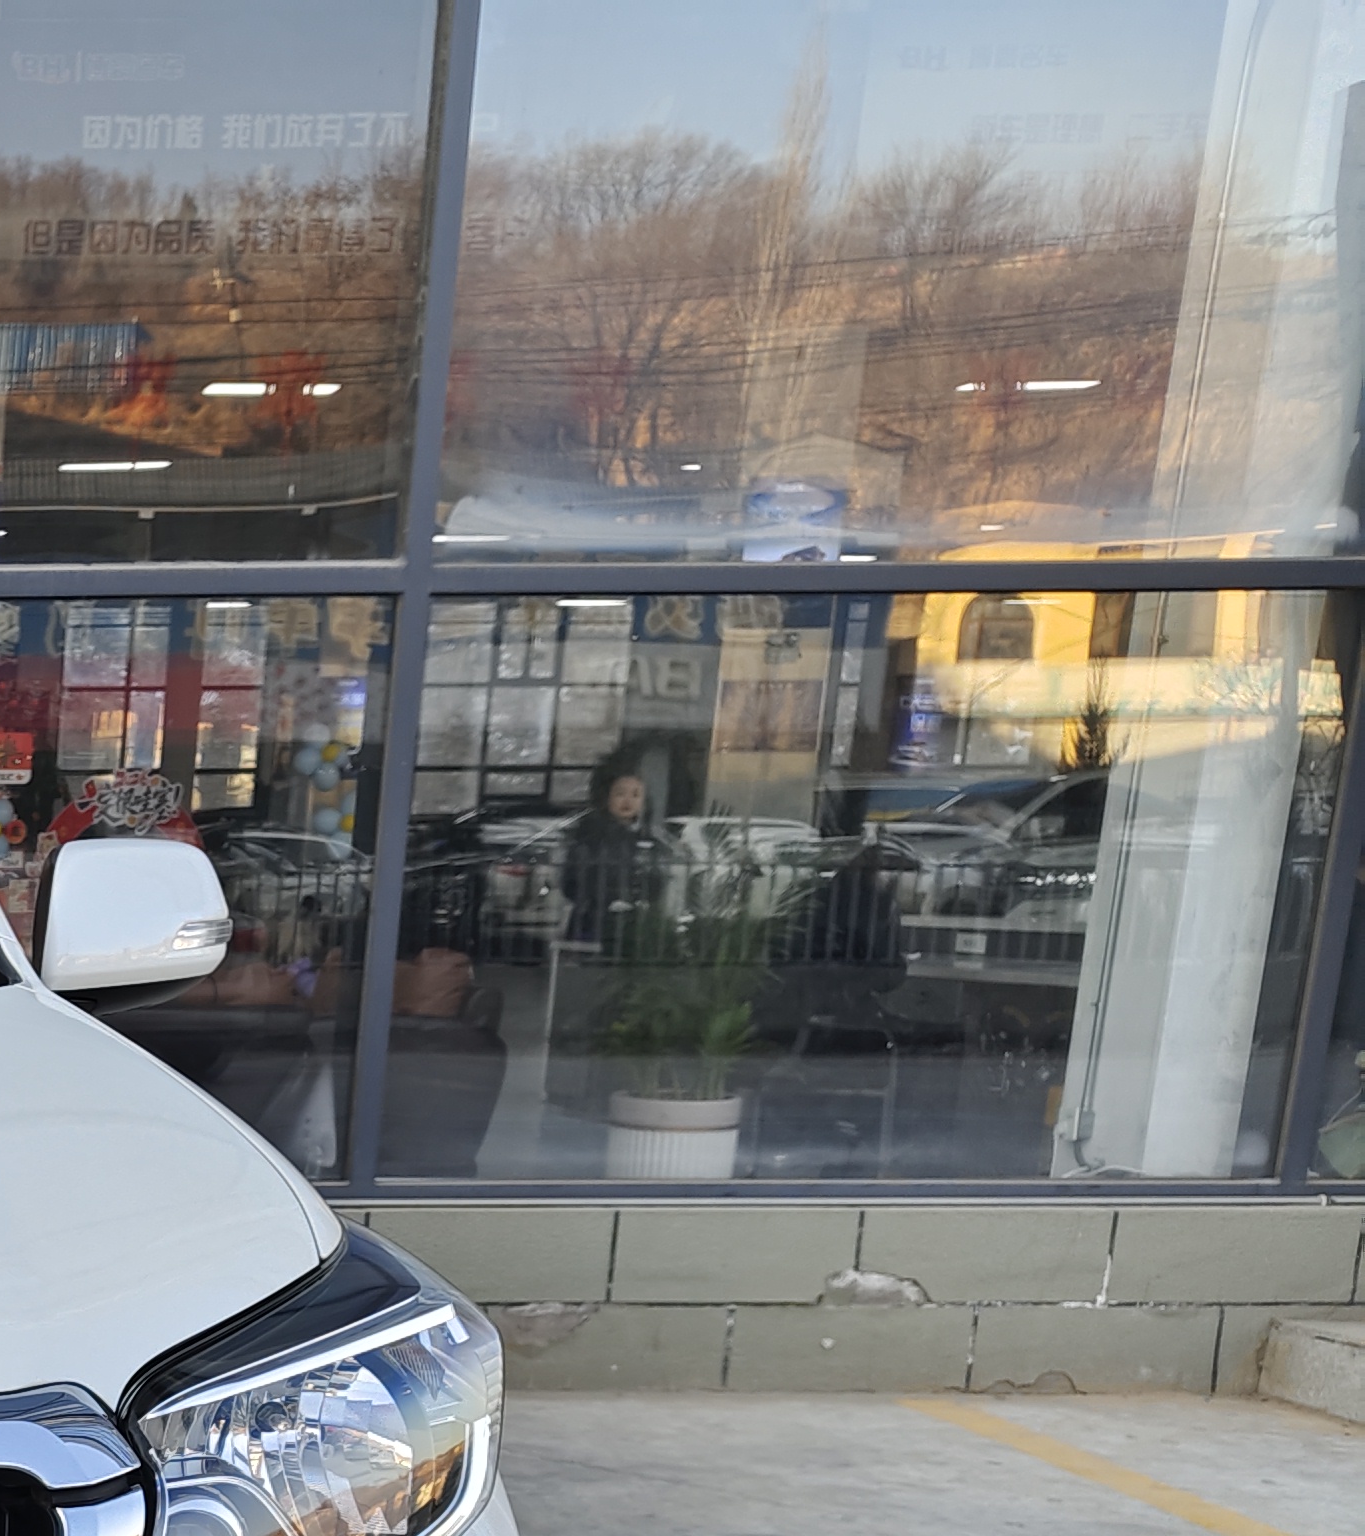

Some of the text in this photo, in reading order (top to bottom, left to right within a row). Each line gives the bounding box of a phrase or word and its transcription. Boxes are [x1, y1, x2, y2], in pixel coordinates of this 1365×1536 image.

[82, 114, 205, 150] 因为价格
[23, 218, 216, 255] 但是因为品质
